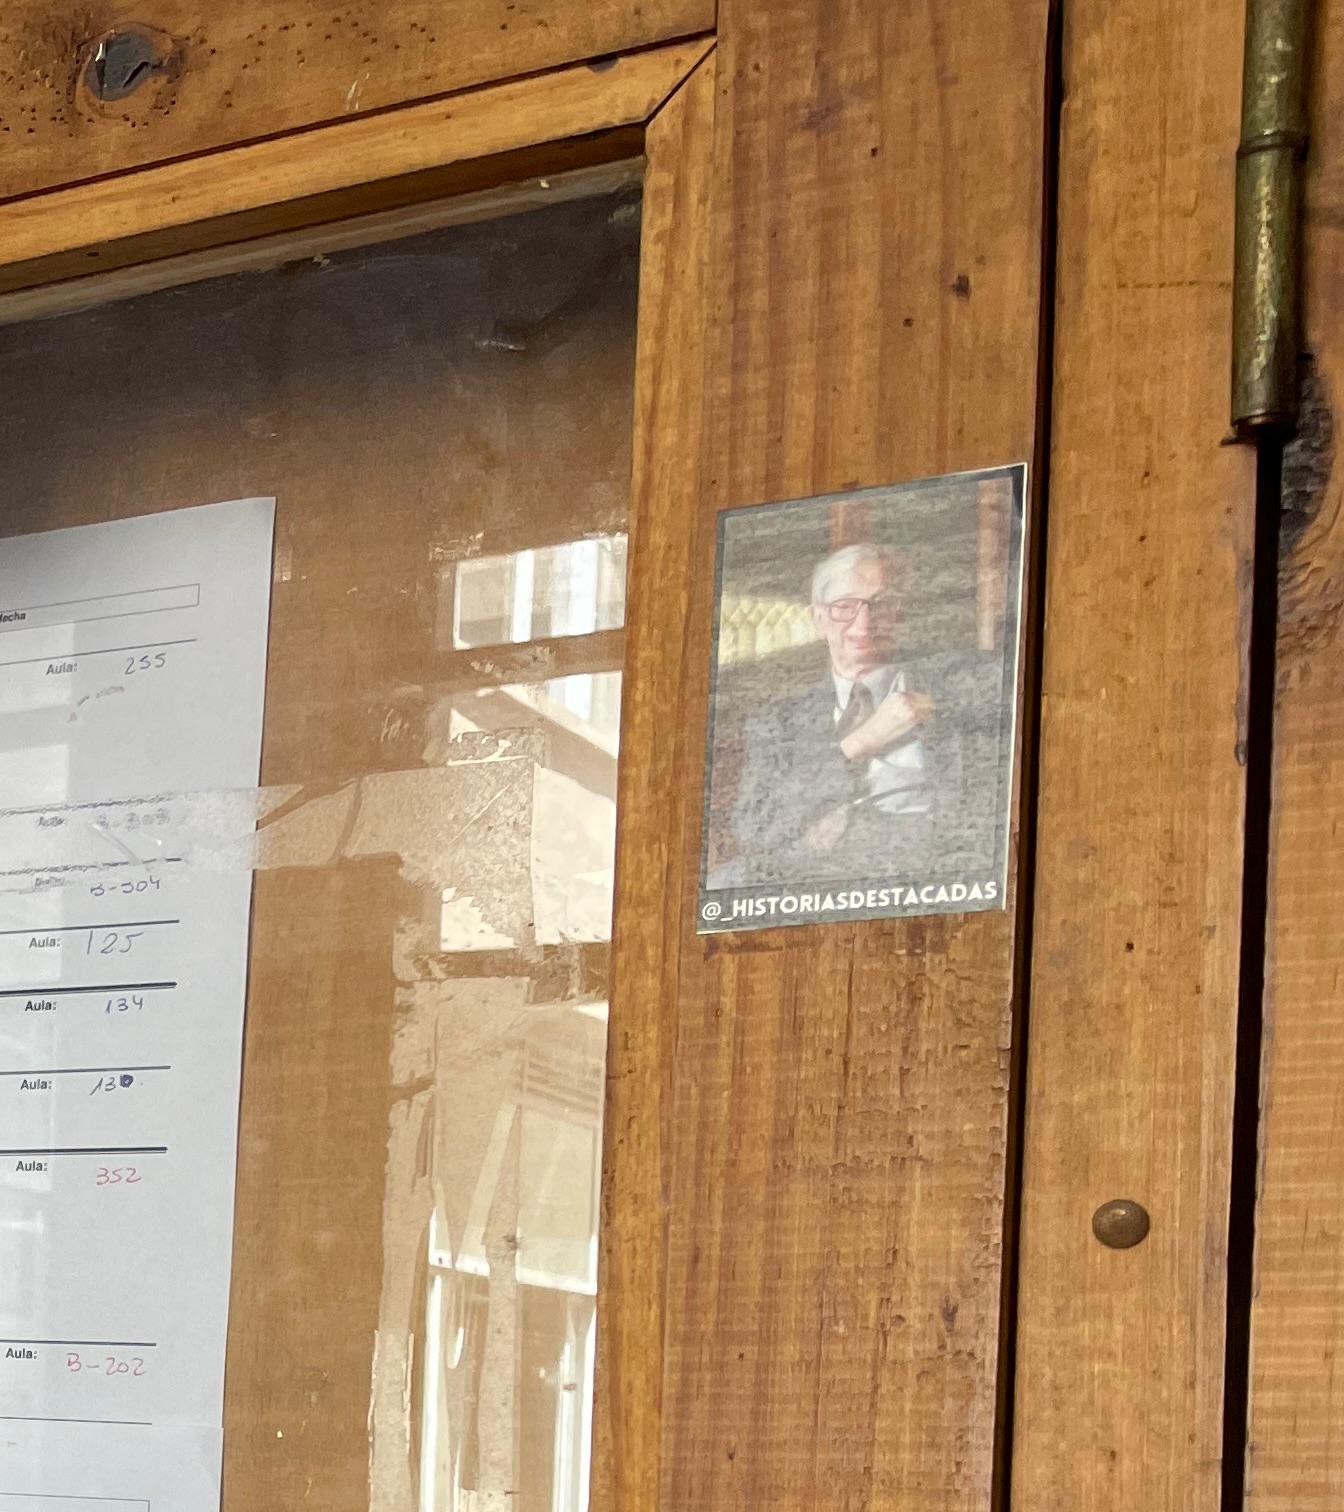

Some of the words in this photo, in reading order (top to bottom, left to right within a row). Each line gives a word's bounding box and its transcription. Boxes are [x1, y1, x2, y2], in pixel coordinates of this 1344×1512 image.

[46, 662, 78, 676] Aula:
[29, 936, 61, 949] Aula:
[25, 999, 57, 1012] Aula:
[16, 1160, 49, 1172] Aula:
[96, 1167, 143, 1186] 352
